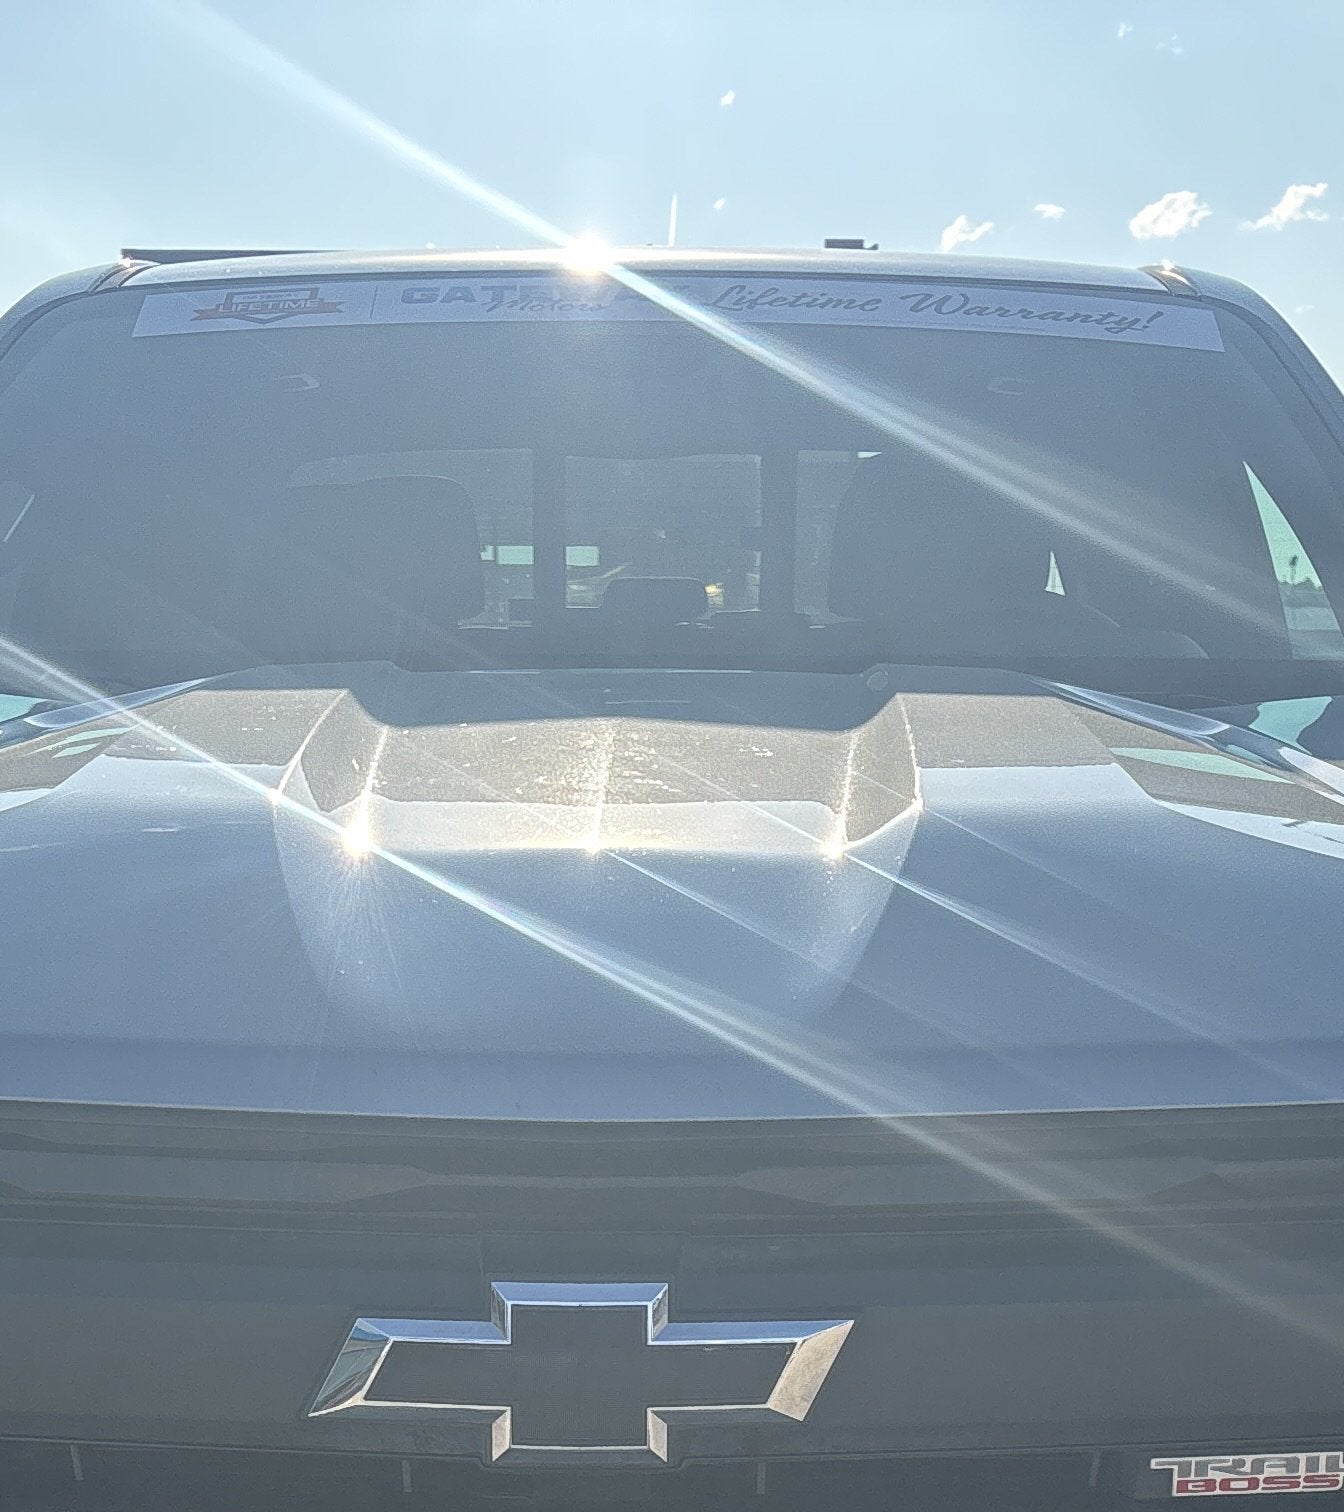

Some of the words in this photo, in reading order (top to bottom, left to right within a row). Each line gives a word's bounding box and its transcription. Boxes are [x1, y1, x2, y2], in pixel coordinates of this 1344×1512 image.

[218, 299, 321, 313] LIFETIME
[712, 284, 881, 312] Lifetime
[899, 292, 1164, 334] Warranty!
[1175, 1473, 1341, 1494] BOSS
